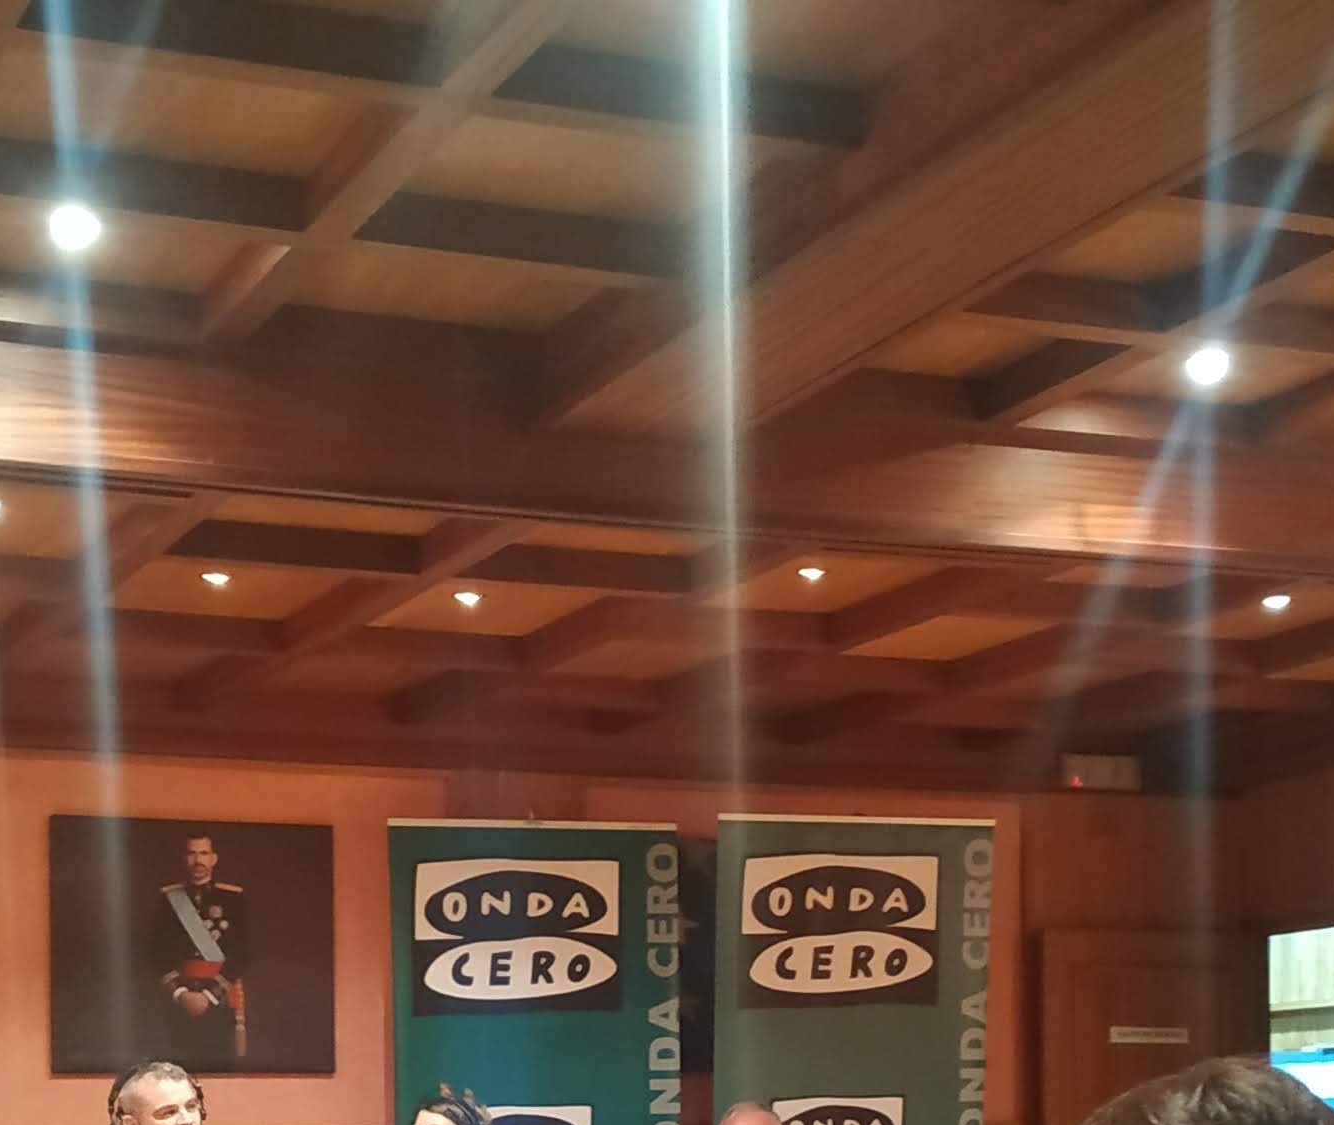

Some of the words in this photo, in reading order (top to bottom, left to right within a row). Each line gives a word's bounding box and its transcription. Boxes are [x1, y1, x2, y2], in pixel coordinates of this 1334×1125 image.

[442, 891, 589, 922] ONDA
[646, 843, 681, 977] CERO
[769, 886, 908, 917] ONDA
[962, 838, 994, 970] CERO
[452, 951, 590, 986] CERO
[775, 945, 908, 980] CERO
